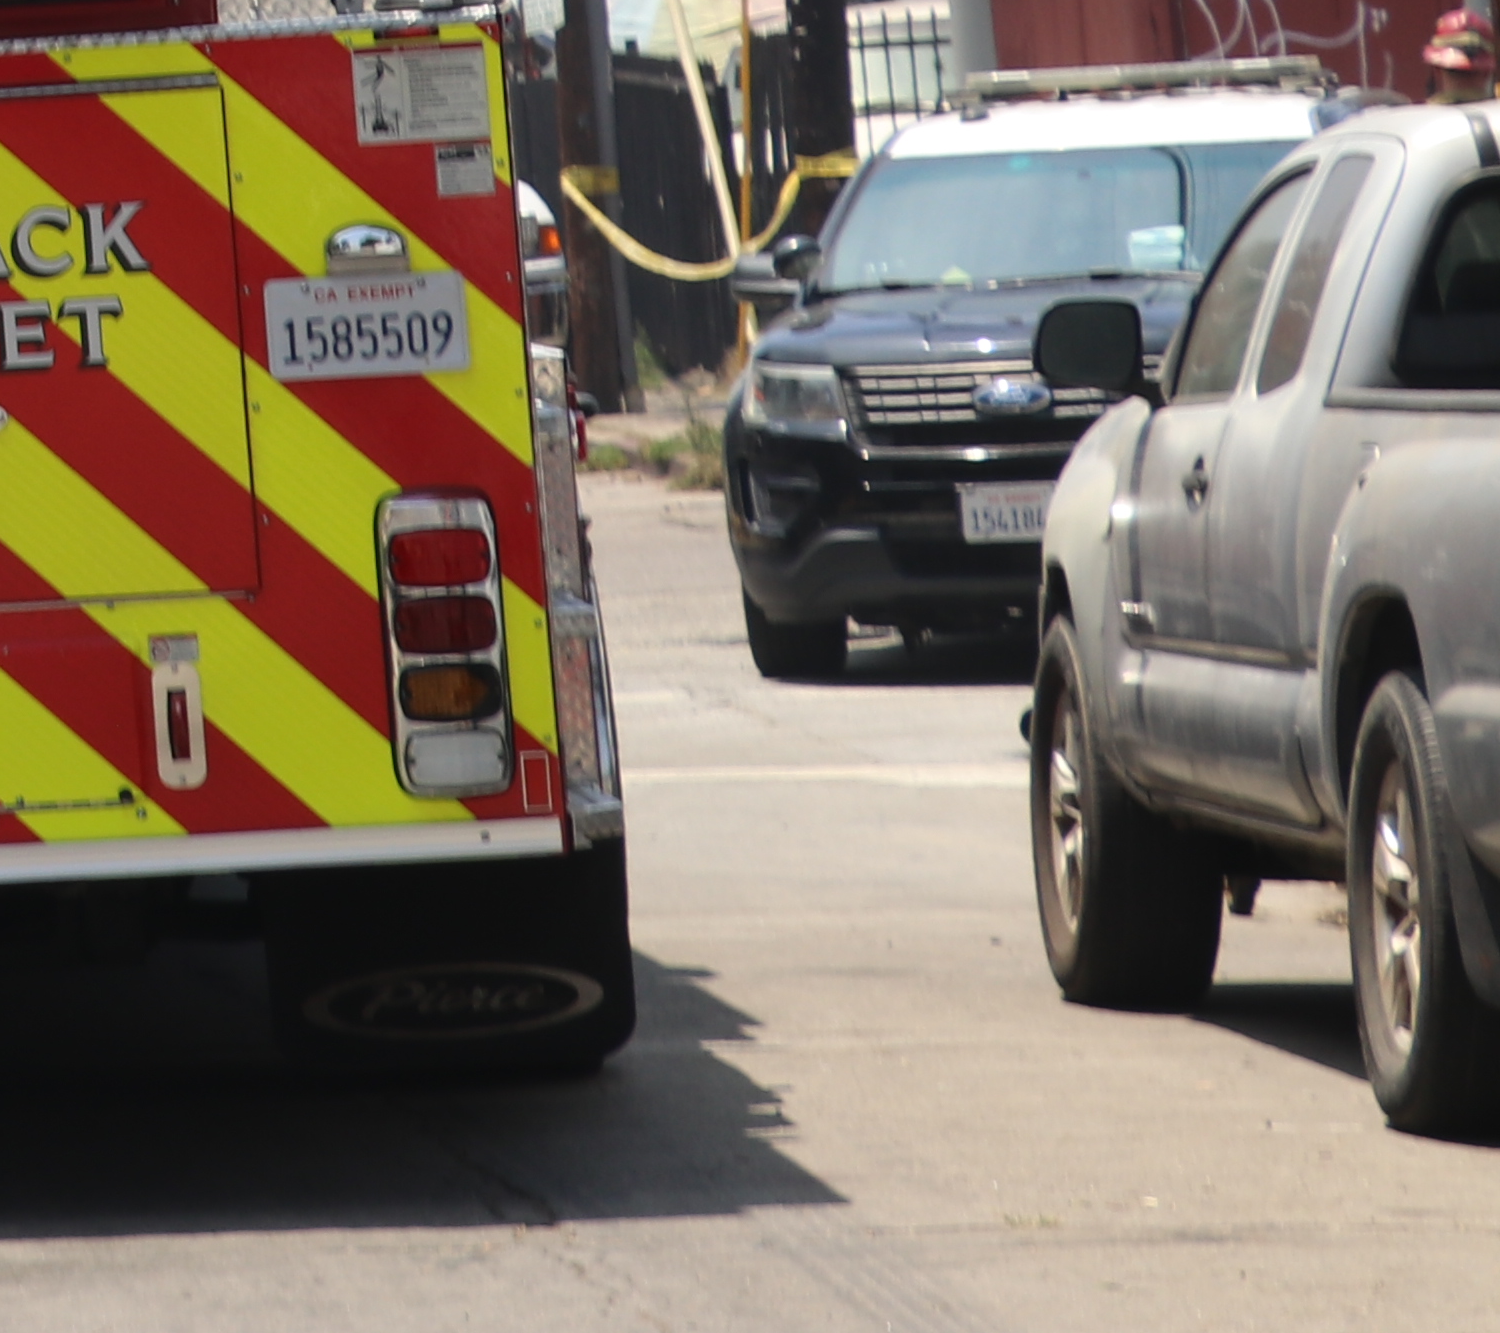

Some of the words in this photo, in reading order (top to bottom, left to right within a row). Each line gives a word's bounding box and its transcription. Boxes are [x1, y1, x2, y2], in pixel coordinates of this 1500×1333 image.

[313, 288, 338, 304] CA
[347, 284, 416, 304] EXEMPT
[283, 307, 454, 367] 1585509
